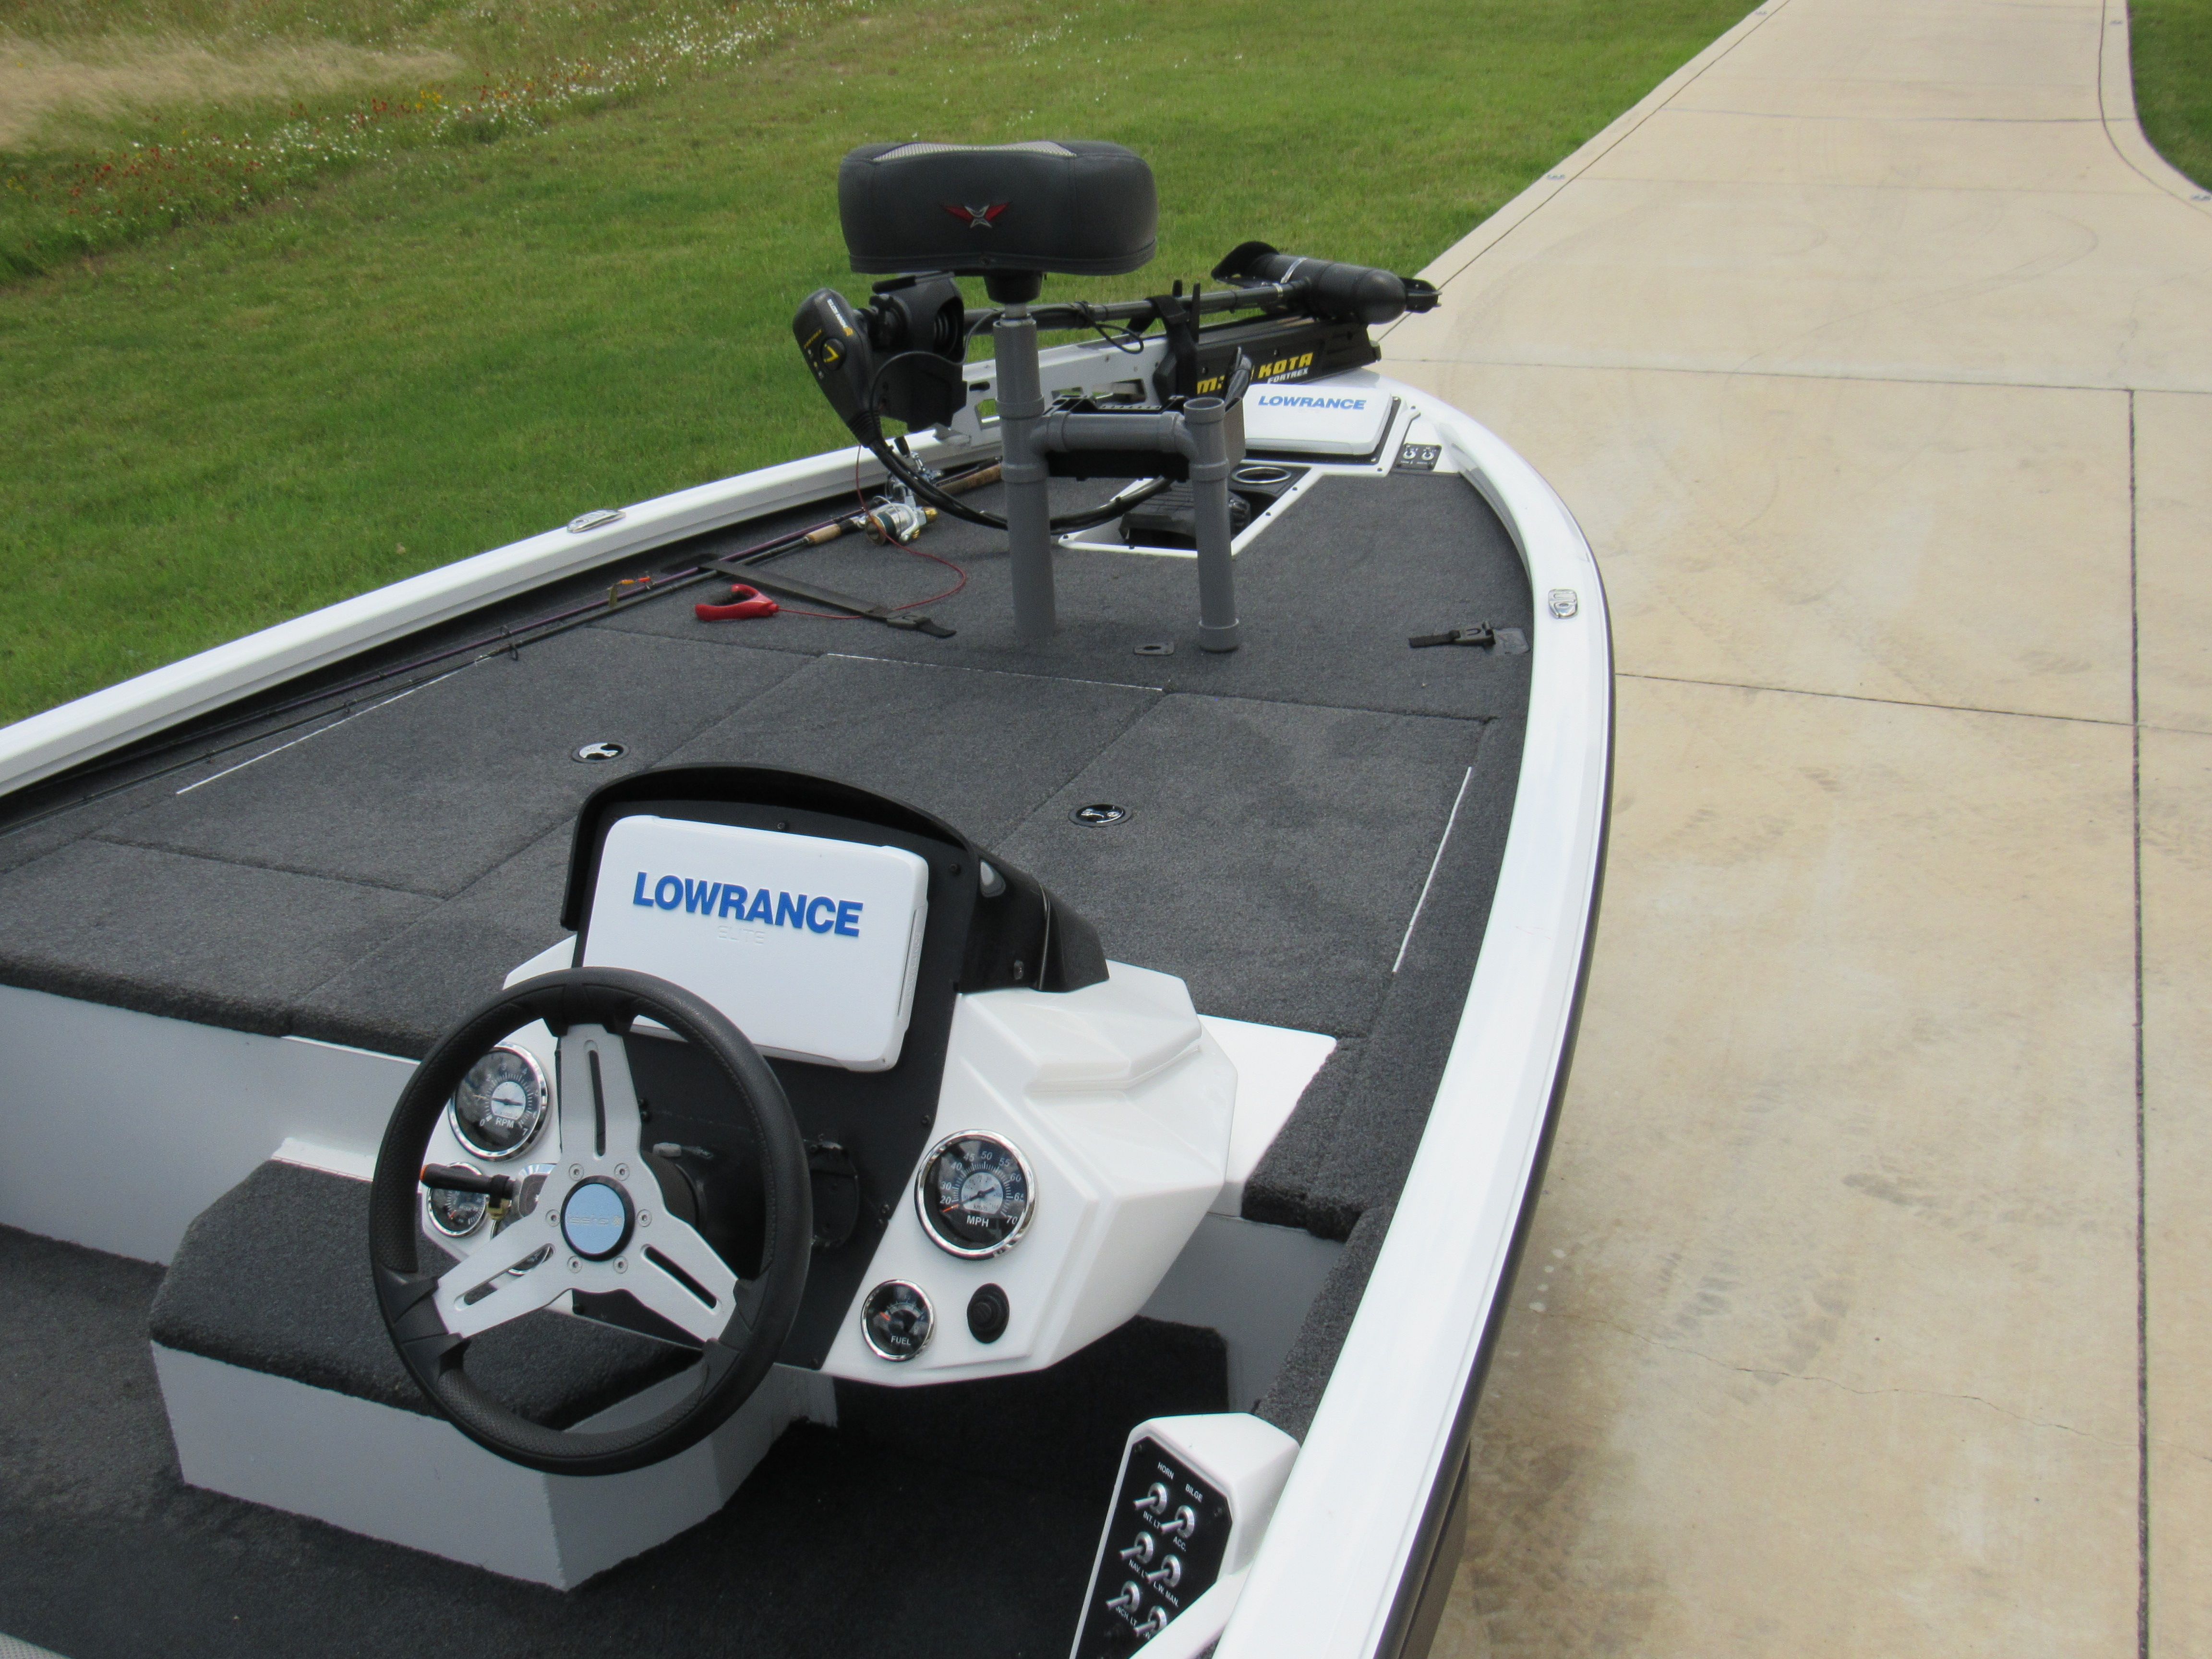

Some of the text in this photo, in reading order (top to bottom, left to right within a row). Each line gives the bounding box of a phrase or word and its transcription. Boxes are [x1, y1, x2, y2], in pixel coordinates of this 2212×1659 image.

[1258, 352, 1313, 379] KOTA
[1267, 367, 1309, 384] FORTREX
[1258, 396, 1367, 410] LOWRANCE
[633, 871, 864, 937] LOWRANCE
[495, 1117, 515, 1129] RPM
[522, 1128, 528, 1137] 7
[963, 1153, 975, 1162] 45
[981, 1152, 993, 1160] 50
[999, 1157, 1010, 1167] 55
[950, 1162, 962, 1171] 40
[1010, 1173, 1022, 1181] 60
[940, 1181, 952, 1190] 30
[940, 1196, 951, 1205] 20
[966, 1214, 989, 1227] MPH
[1006, 1215, 1018, 1225] 70
[890, 1335, 911, 1345] FUEL
[1157, 1462, 1174, 1480] HORN
[1185, 1483, 1203, 1503] BILGE
[1143, 1511, 1153, 1524] INT.
[1173, 1536, 1186, 1552] ACC.
[1129, 1559, 1141, 1574] NAV.
[1153, 1581, 1179, 1607] L.W. MAN.
[1116, 1606, 1130, 1622] NCH.
